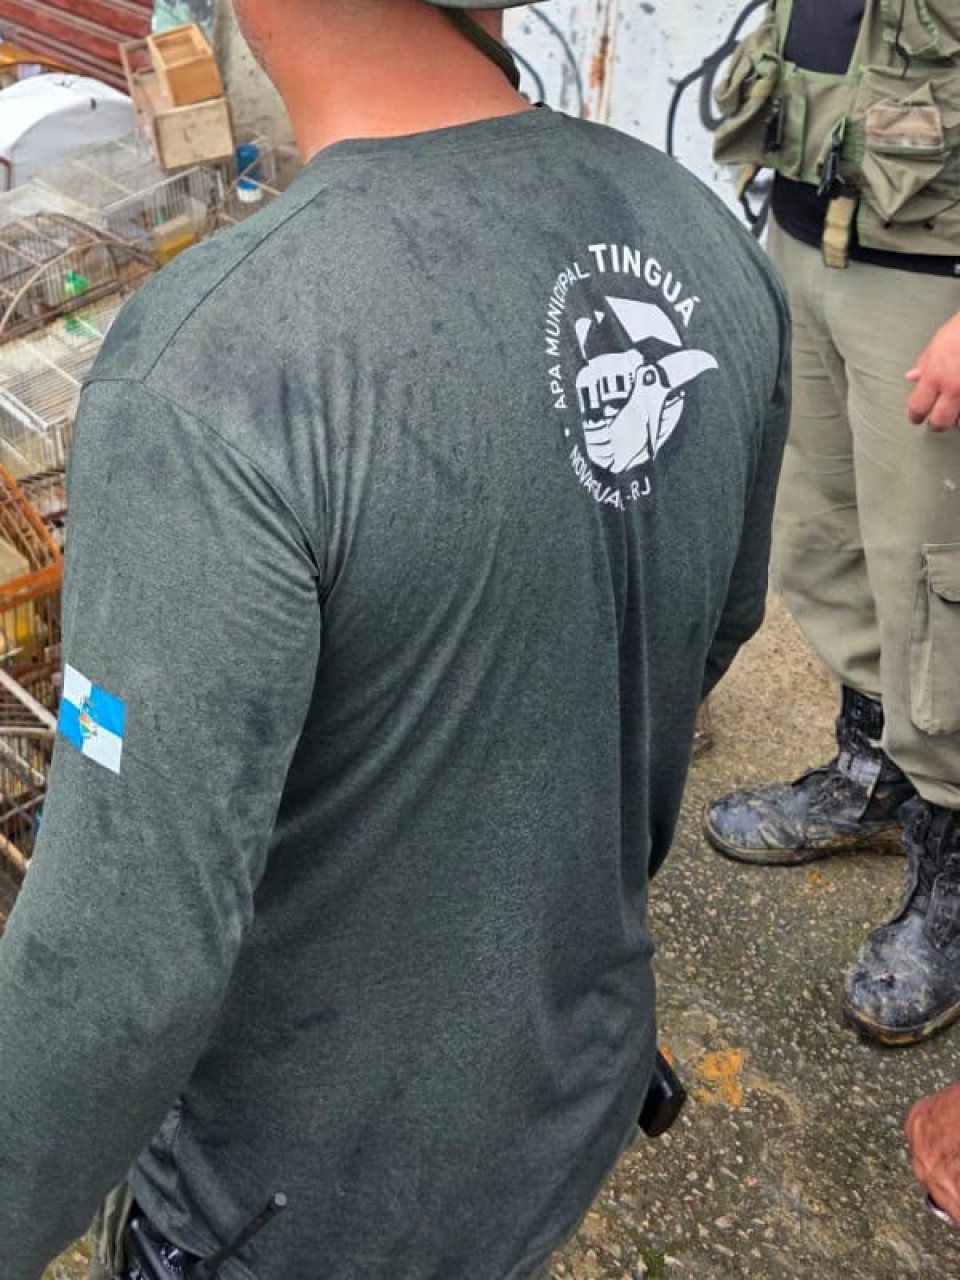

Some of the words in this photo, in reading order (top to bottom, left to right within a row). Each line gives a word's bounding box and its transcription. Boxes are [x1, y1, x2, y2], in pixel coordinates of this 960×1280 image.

[544, 262, 591, 356] MUNICIPAL
[588, 243, 701, 327] TINGUÁ
[548, 364, 567, 409] APA
